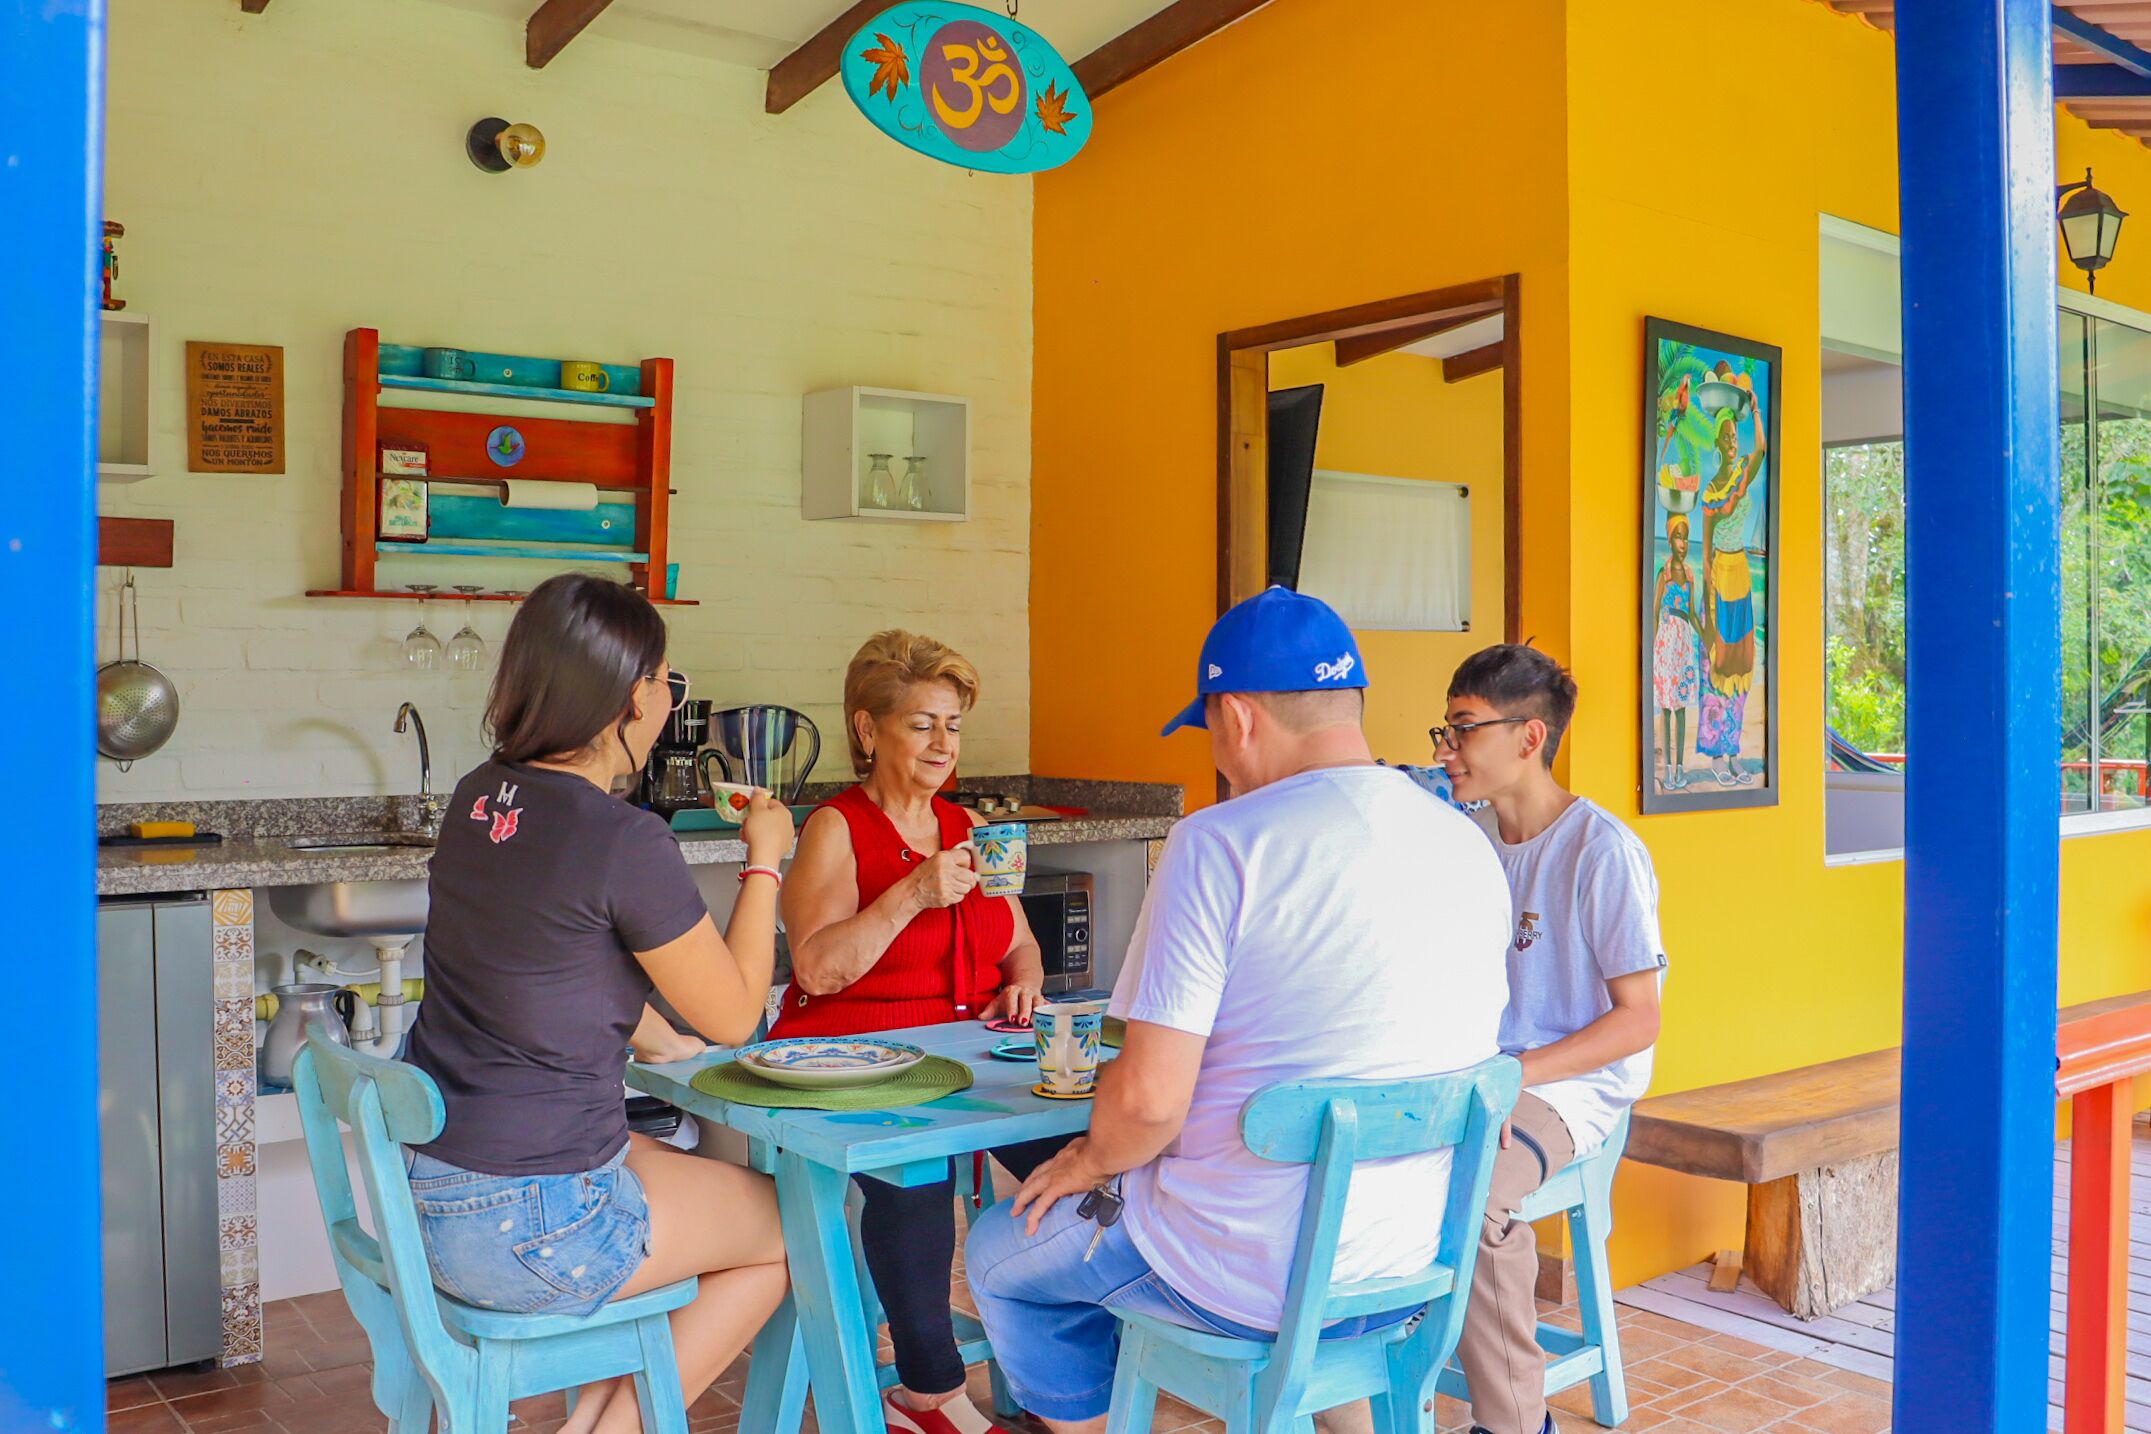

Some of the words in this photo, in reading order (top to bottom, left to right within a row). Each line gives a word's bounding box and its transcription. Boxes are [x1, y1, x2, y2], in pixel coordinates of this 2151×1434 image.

[207, 353, 218, 361] EN
[222, 354, 242, 362] ESTA
[244, 355, 264, 363] CASA
[207, 362, 235, 372] SOMOS
[237, 363, 265, 373] REALES
[578, 372, 599, 382] Coff
[201, 399, 218, 407] NOS
[221, 400, 272, 409] DIVERTIMOS
[201, 407, 231, 417] DAMOS
[235, 409, 272, 419] ABRAZOS
[201, 421, 242, 434] hacemos
[246, 422, 272, 434] ruido
[202, 449, 220, 457] NOS
[224, 450, 272, 459] QUEREMOS
[389, 453, 418, 463] Nexcare
[496, 781, 518, 806] M
